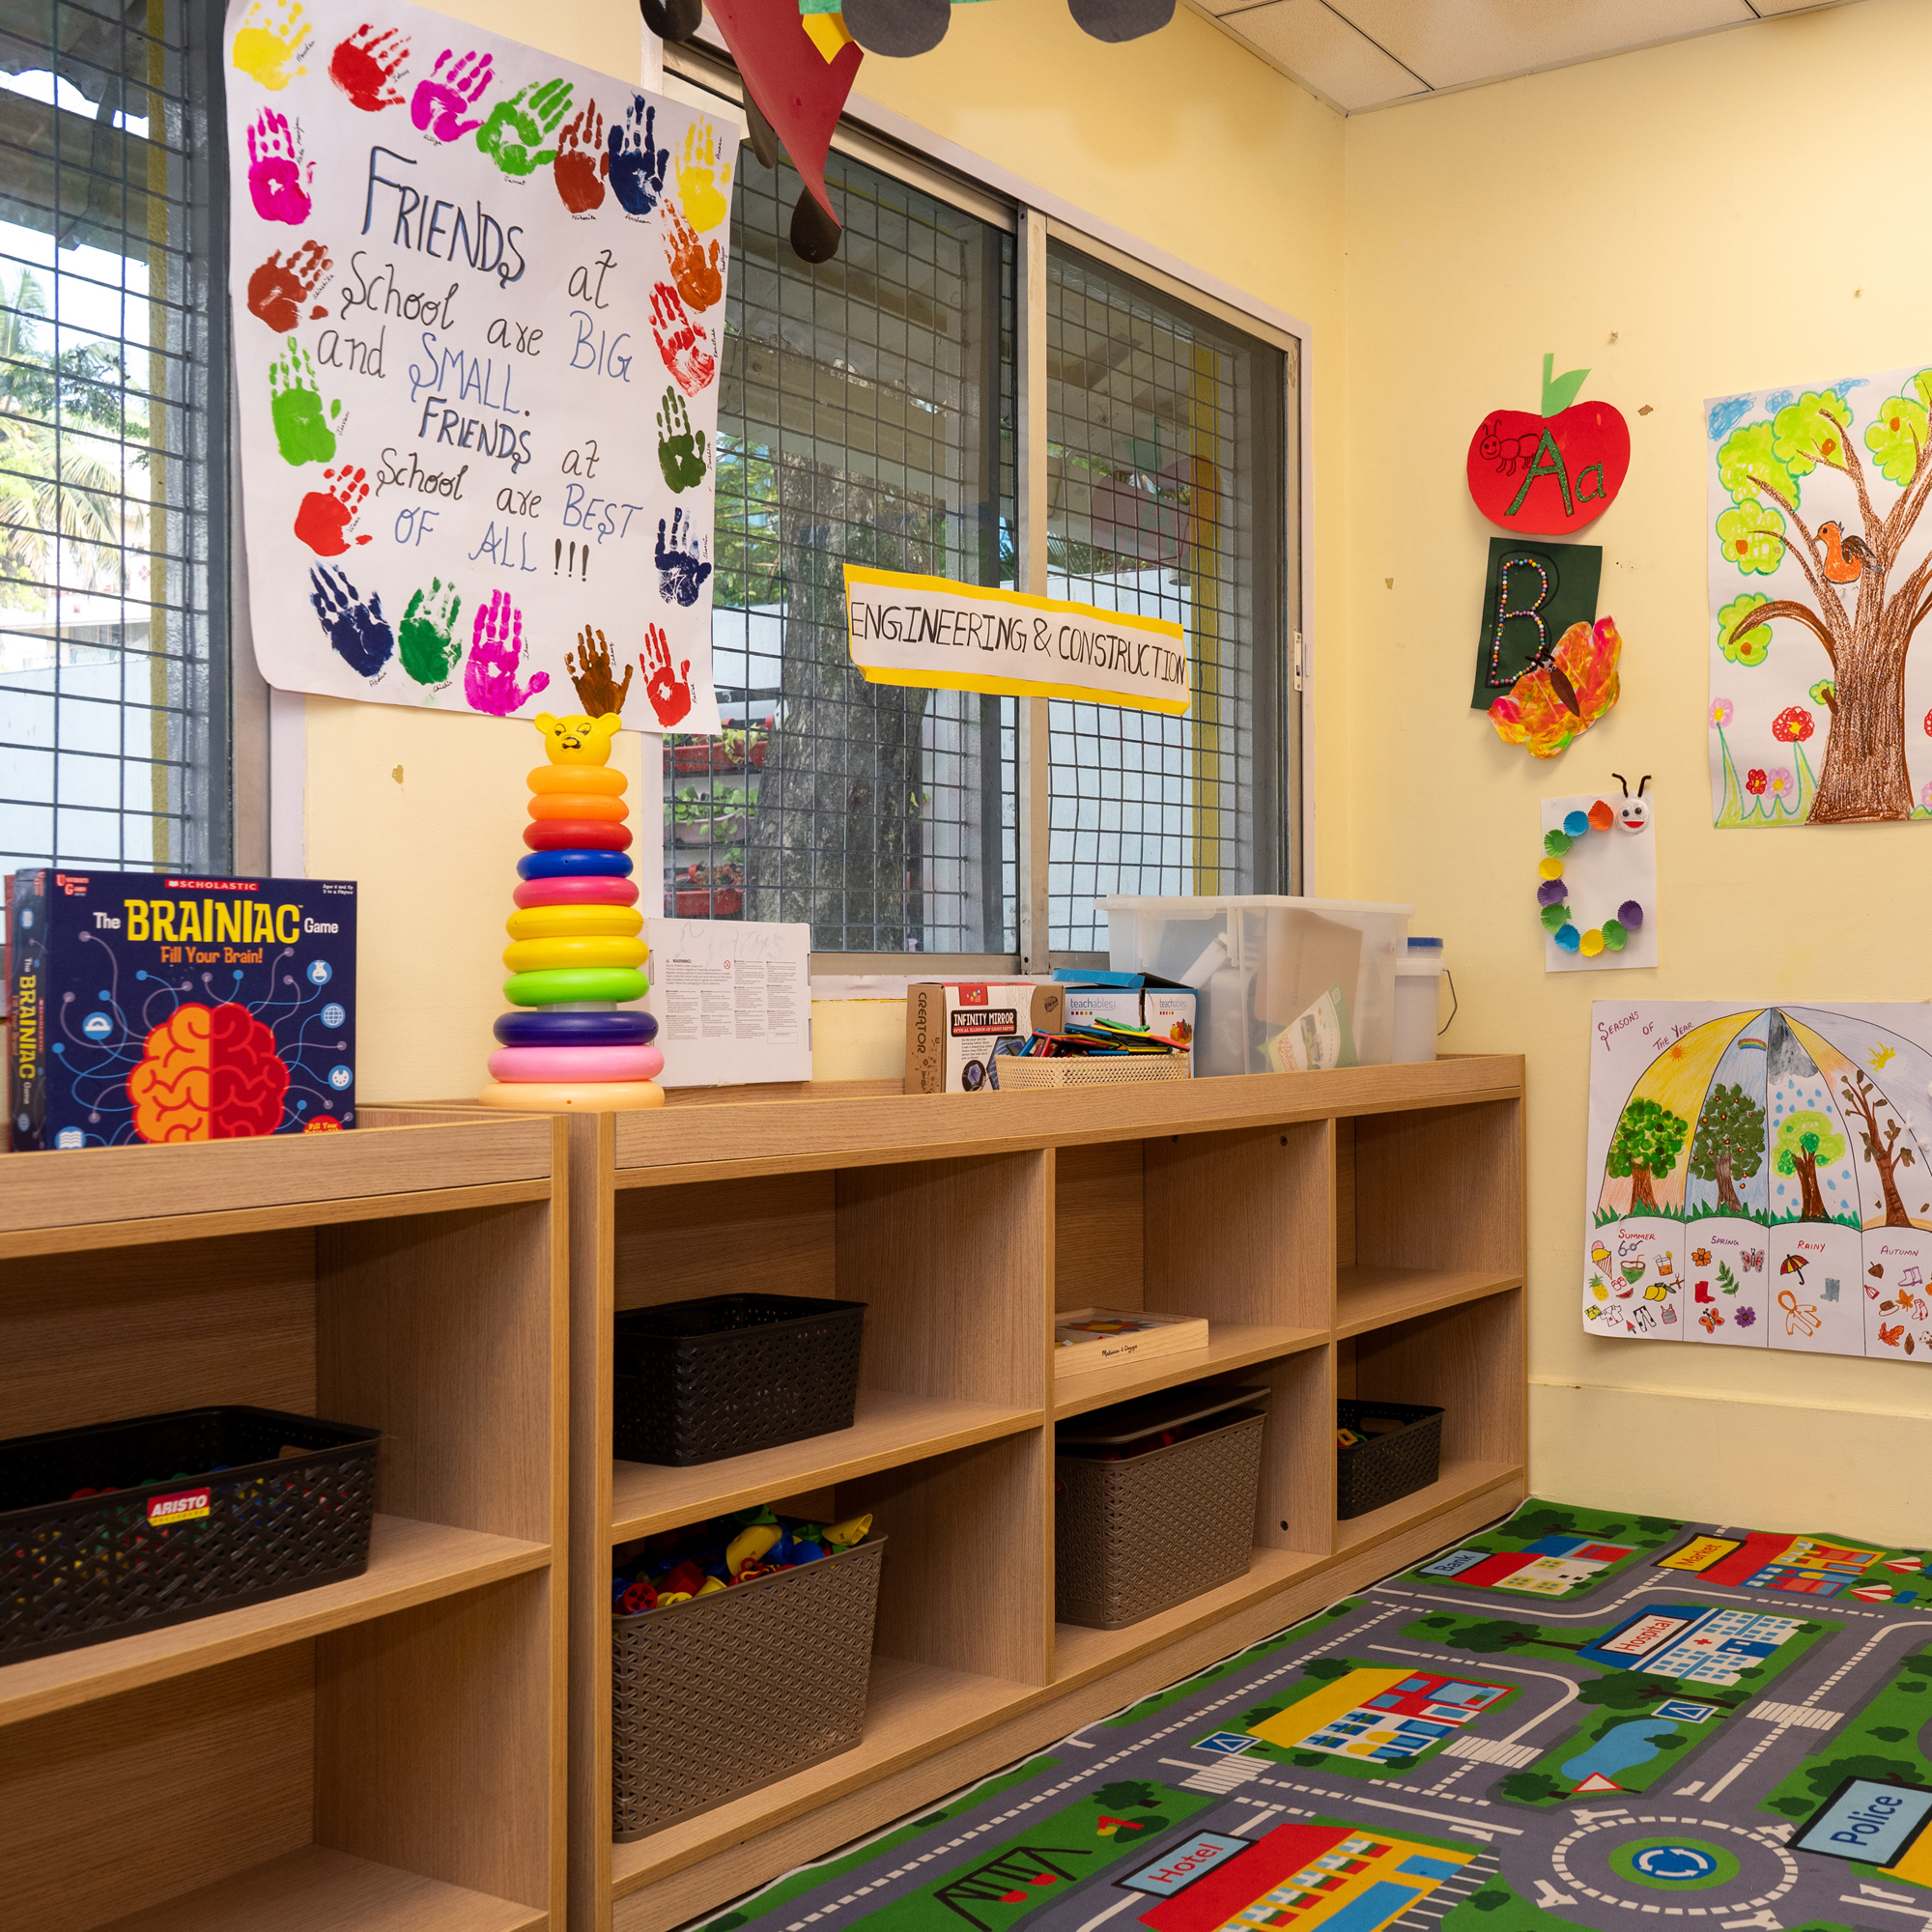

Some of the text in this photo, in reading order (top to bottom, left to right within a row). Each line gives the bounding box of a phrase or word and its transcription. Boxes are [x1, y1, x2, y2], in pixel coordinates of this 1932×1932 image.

[362, 146, 617, 308] FRIENDS at
[341, 251, 459, 329] School
[488, 318, 543, 356] are
[570, 310, 632, 382] BIG
[318, 326, 530, 417] and SMALL.
[418, 397, 599, 478] FRIENDS at
[377, 448, 642, 544] School are BEST
[395, 506, 589, 582] OF ALL !!!
[851, 601, 1185, 686] ENGINEERING & CONSTRUCTION
[179, 880, 256, 891] SCHOLASTIC
[93, 898, 339, 944] The BRAINIAC Game
[160, 946, 264, 965] Fill Your Brain!
[916, 991, 927, 1054] CREATOR
[953, 1011, 1014, 1027] INFINITY MIRROR
[1070, 998, 1113, 1009] teachables
[1159, 998, 1187, 1009] teachables
[19, 975, 37, 1080] BRAINIAC
[1642, 1021, 1654, 1036] OF
[151, 1493, 208, 1518] ARISTO
[1438, 1551, 1477, 1573] Bank
[1677, 1543, 1723, 1570] Market
[1615, 1618, 1674, 1654] Hospital
[1830, 1795, 1904, 1847] Police
[1149, 1840, 1224, 1886] Hotel
